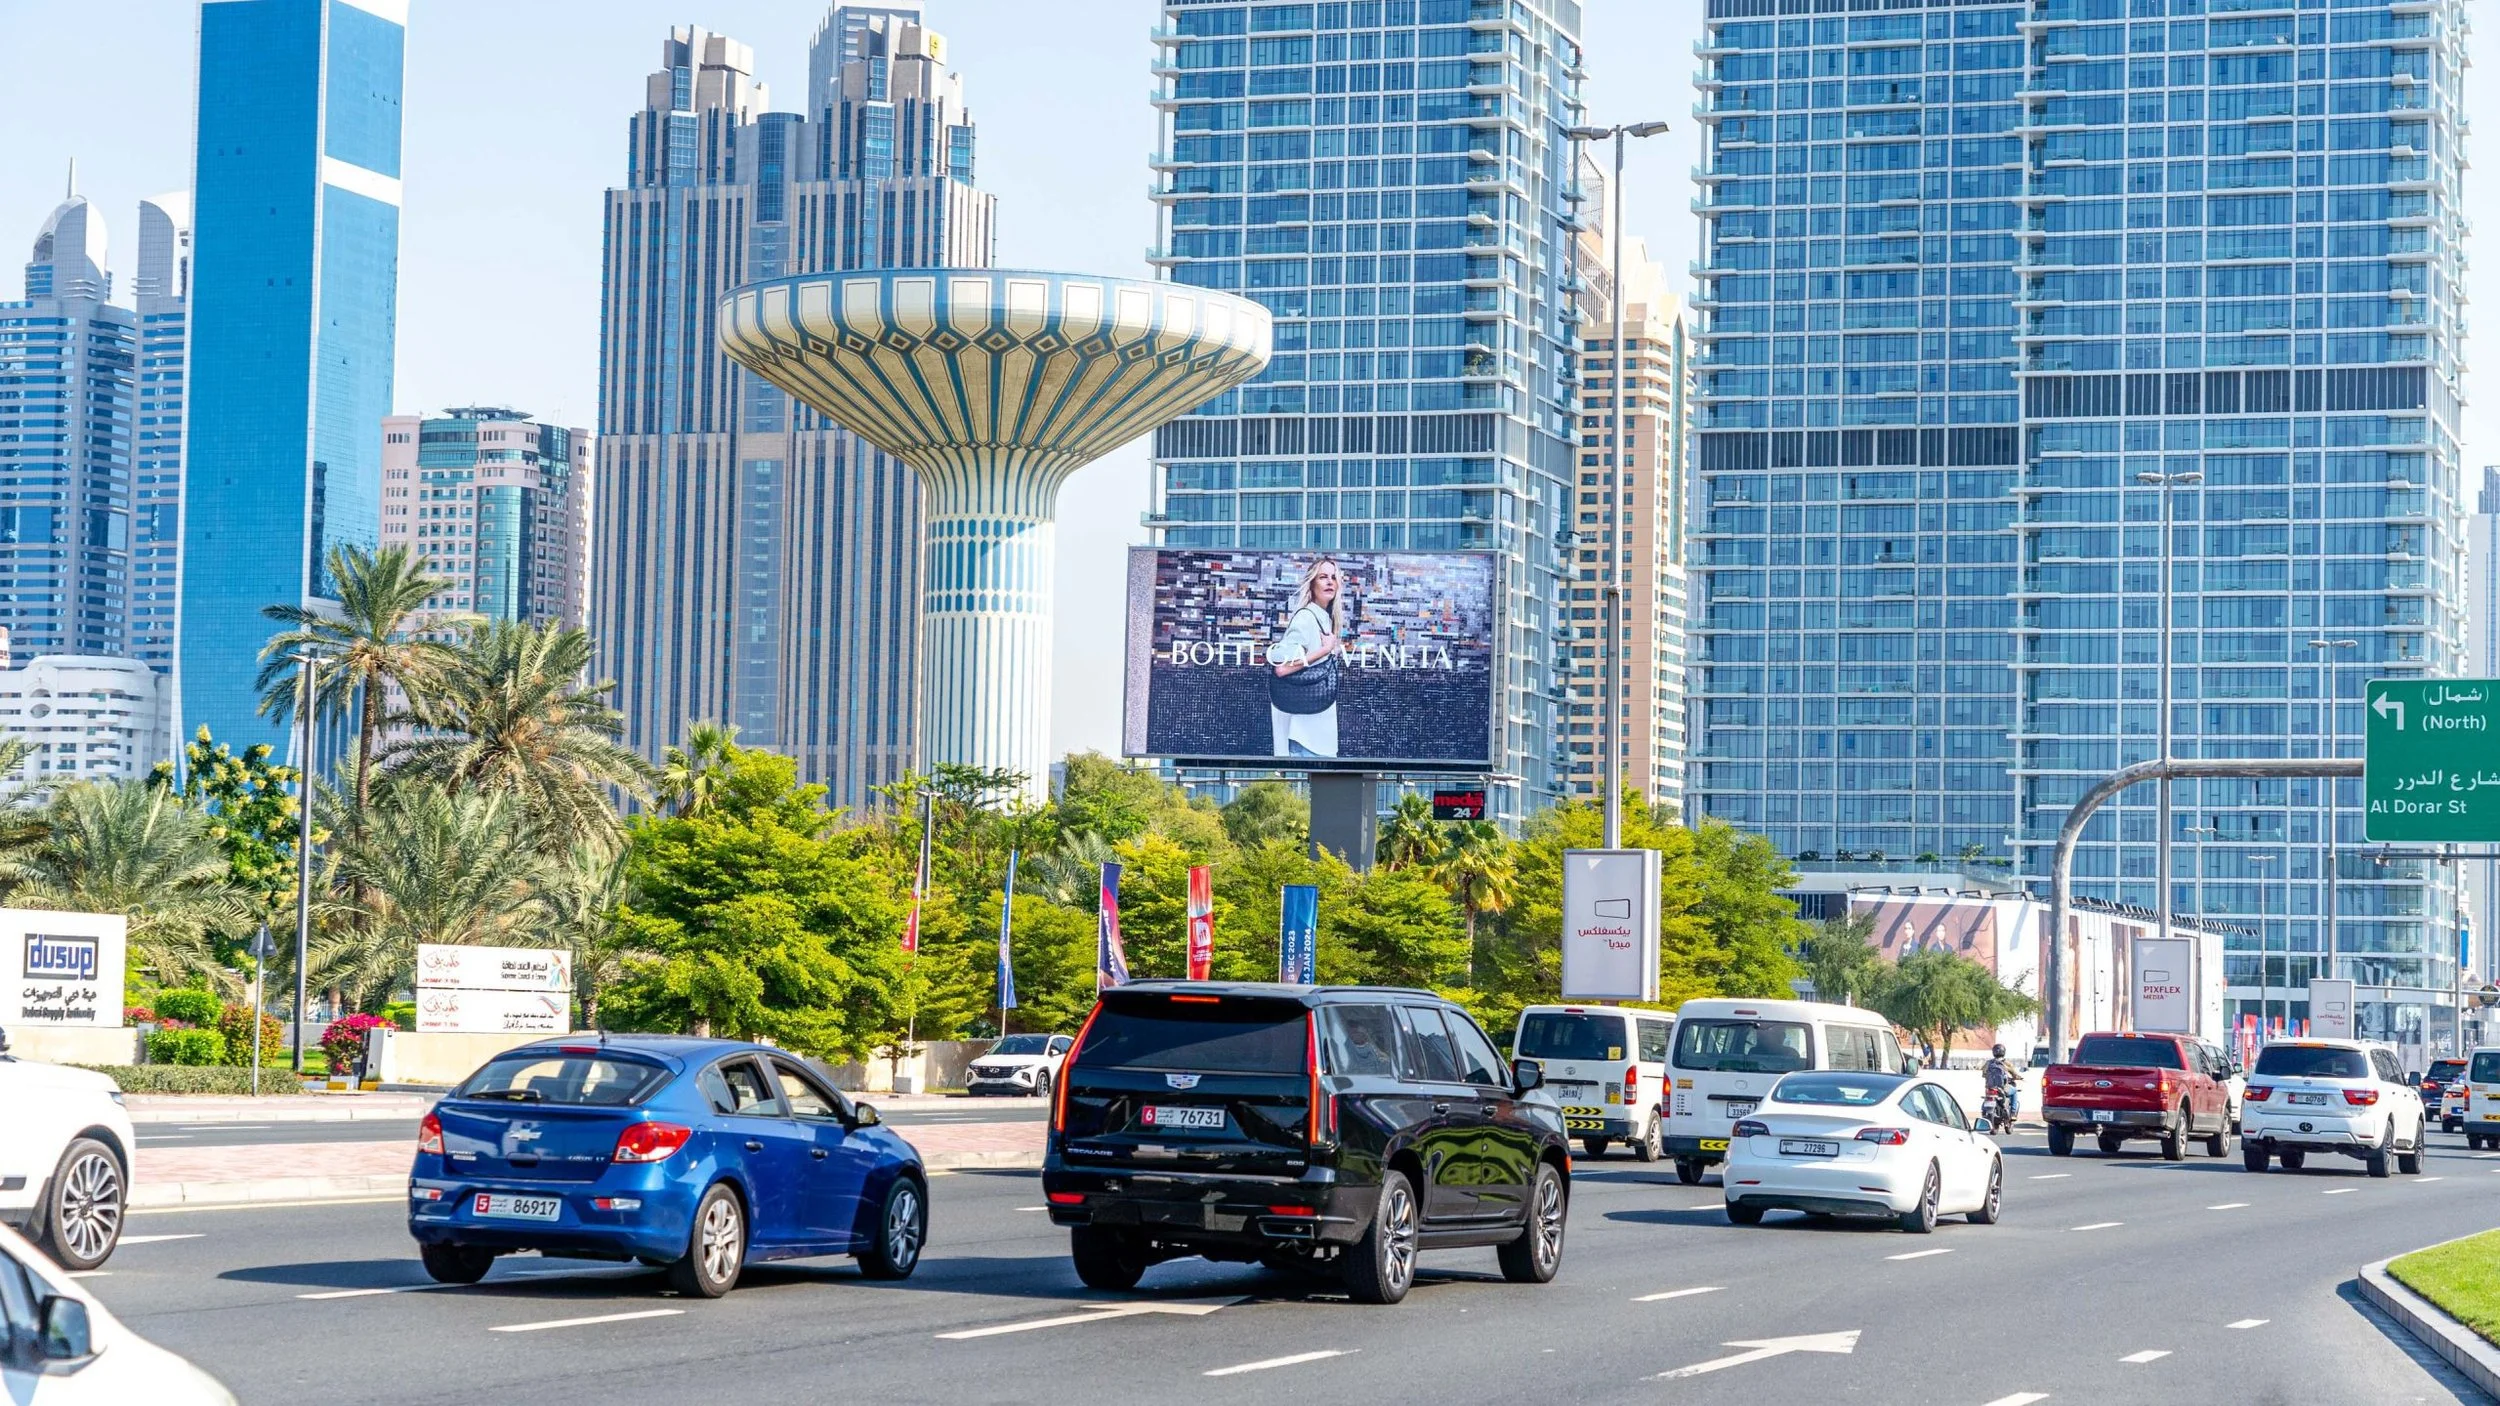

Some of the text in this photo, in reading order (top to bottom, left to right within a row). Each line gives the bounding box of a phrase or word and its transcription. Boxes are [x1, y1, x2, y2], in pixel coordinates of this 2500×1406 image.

[1340, 643, 1453, 669] VENETA
[2422, 714, 2487, 732] (North)
[2393, 769, 2443, 791] الدرر
[2370, 799, 2467, 814] Al Dorar St
[1288, 930, 1296, 953] 2023
[1304, 928, 1312, 951] 2024
[1608, 939, 1631, 949] ميديا
[30, 934, 93, 980] dusup
[2143, 985, 2181, 994] PIXFLEX
[42, 1006, 65, 1021] Supply
[66, 1007, 96, 1021] Authority
[1145, 1109, 1154, 1122] 6
[1180, 1109, 1222, 1126] 76731
[478, 1197, 488, 1211] 5
[513, 1198, 557, 1216] 86917
